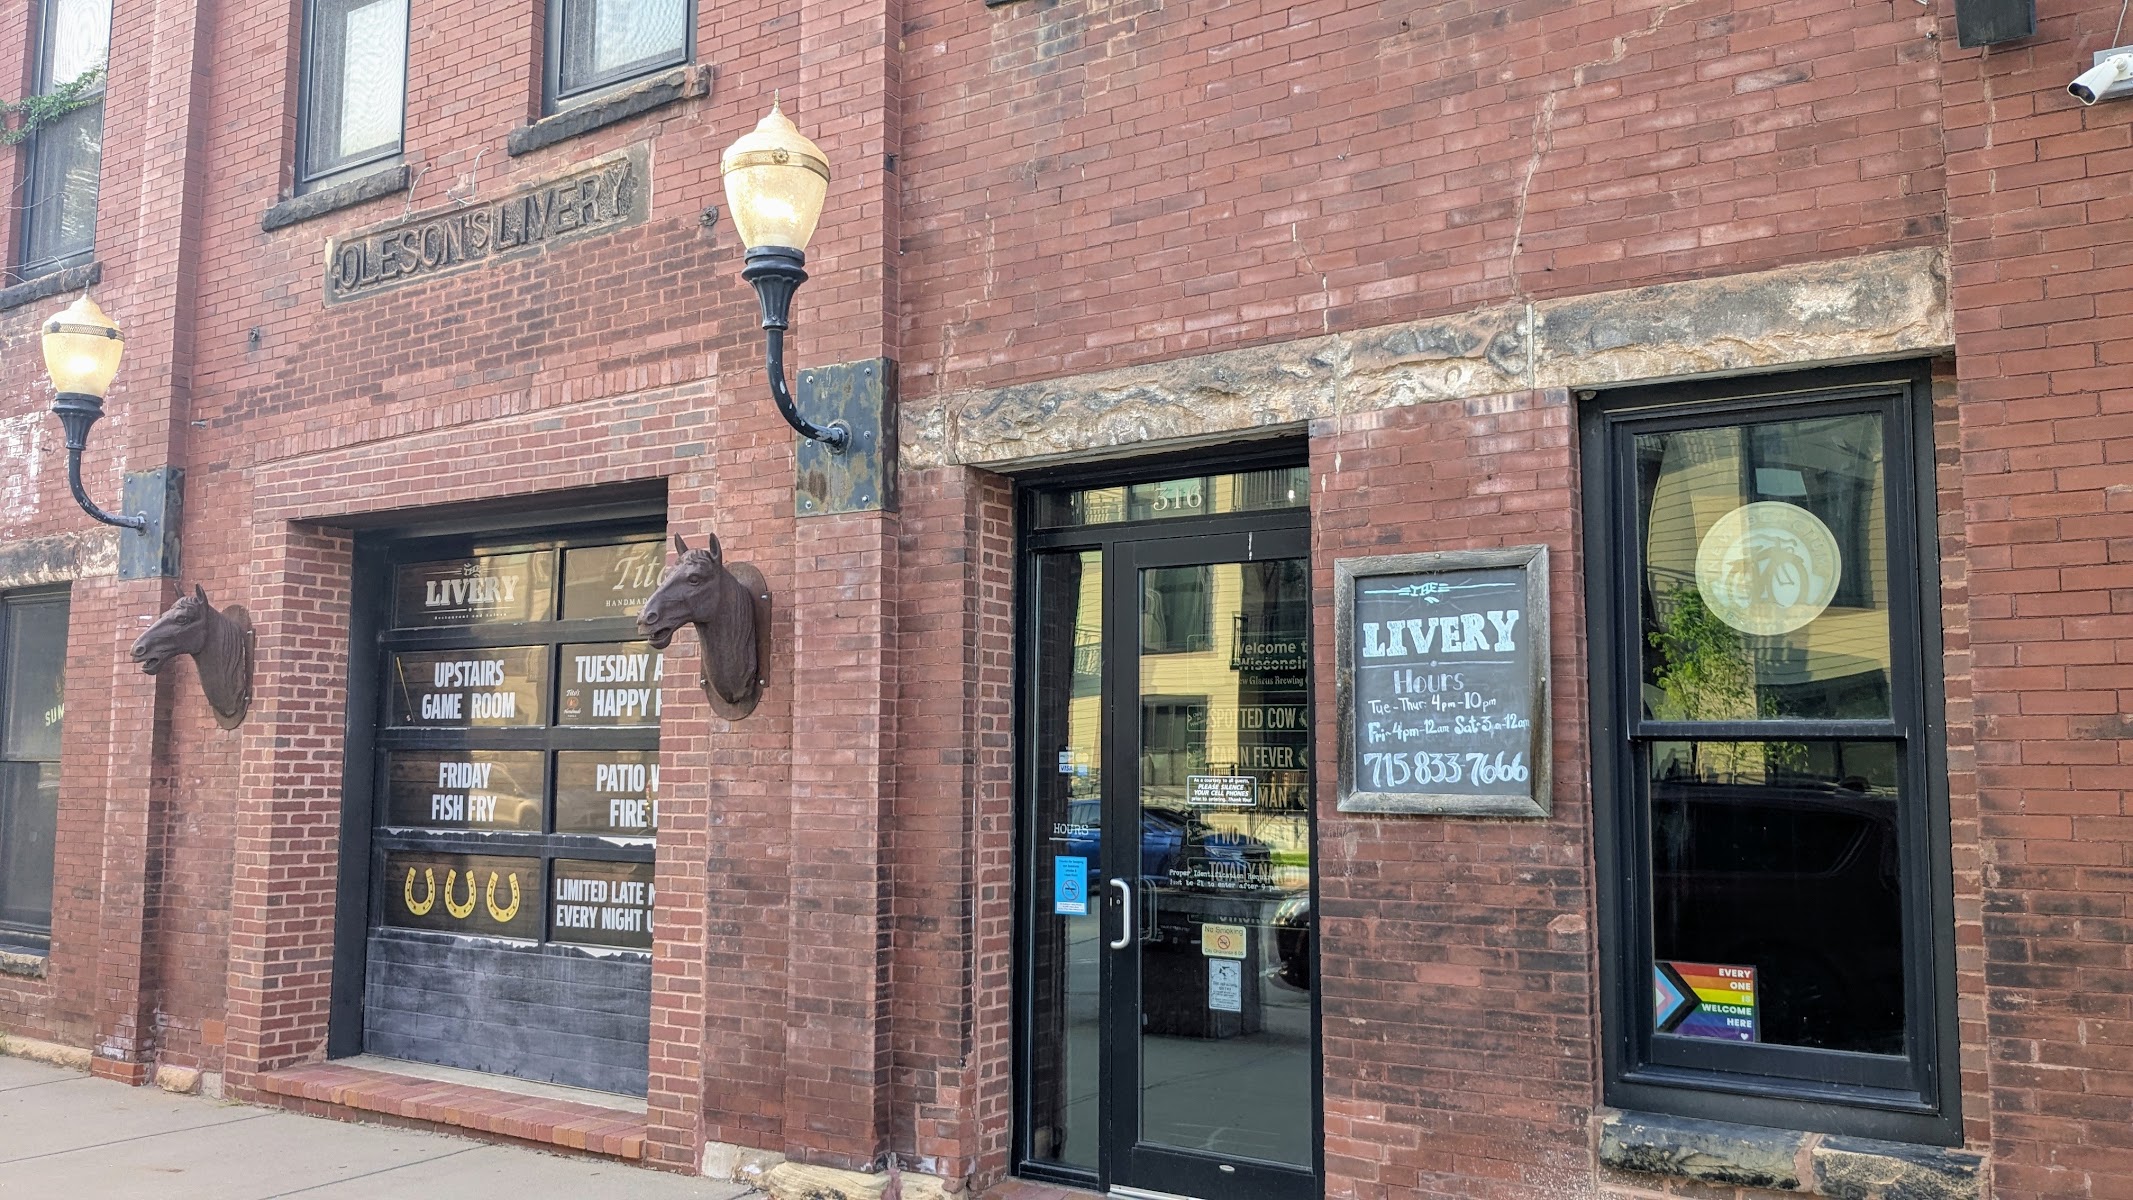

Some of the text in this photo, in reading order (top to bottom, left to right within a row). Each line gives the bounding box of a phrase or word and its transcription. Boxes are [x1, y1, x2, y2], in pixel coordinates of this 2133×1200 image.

[339, 162, 630, 290] OLESON'S LIVERY
[1153, 485, 1202, 511] 316
[425, 575, 519, 606] LIVERY
[1410, 582, 1439, 597] THE
[605, 598, 648, 607] HANDMAD
[1363, 610, 1519, 657] LIVERY
[434, 660, 505, 688] UPSTAIRS
[575, 654, 647, 683] TUESDAY
[1393, 669, 1465, 694] Hours
[422, 692, 516, 720] GAME ROOM
[592, 689, 650, 717] HAPPY
[1267, 707, 1297, 728] COW
[1253, 746, 1294, 768] FEVER
[1363, 750, 1529, 787] 715-833-7666
[439, 762, 491, 789] FRIDAY
[596, 764, 646, 792] PATIO
[431, 794, 497, 822] FISH FRY
[1257, 786, 1288, 808] MAN
[610, 799, 647, 828] FIRE
[1053, 823, 1089, 836] HOURS
[1214, 823, 1240, 845] TWO
[1208, 861, 1256, 883] TOTALLY
[556, 878, 608, 903] LIMITED
[611, 881, 644, 905] LATE
[556, 904, 598, 928] EVERY
[602, 907, 643, 932] NIGHT
[1204, 925, 1244, 936] No Smoking
[1718, 968, 1751, 978] EVERY
[1730, 982, 1751, 990] ONE
[1701, 1003, 1752, 1015] WELCOME
[1741, 995, 1750, 1003] IS
[1726, 1018, 1752, 1028] HERE
